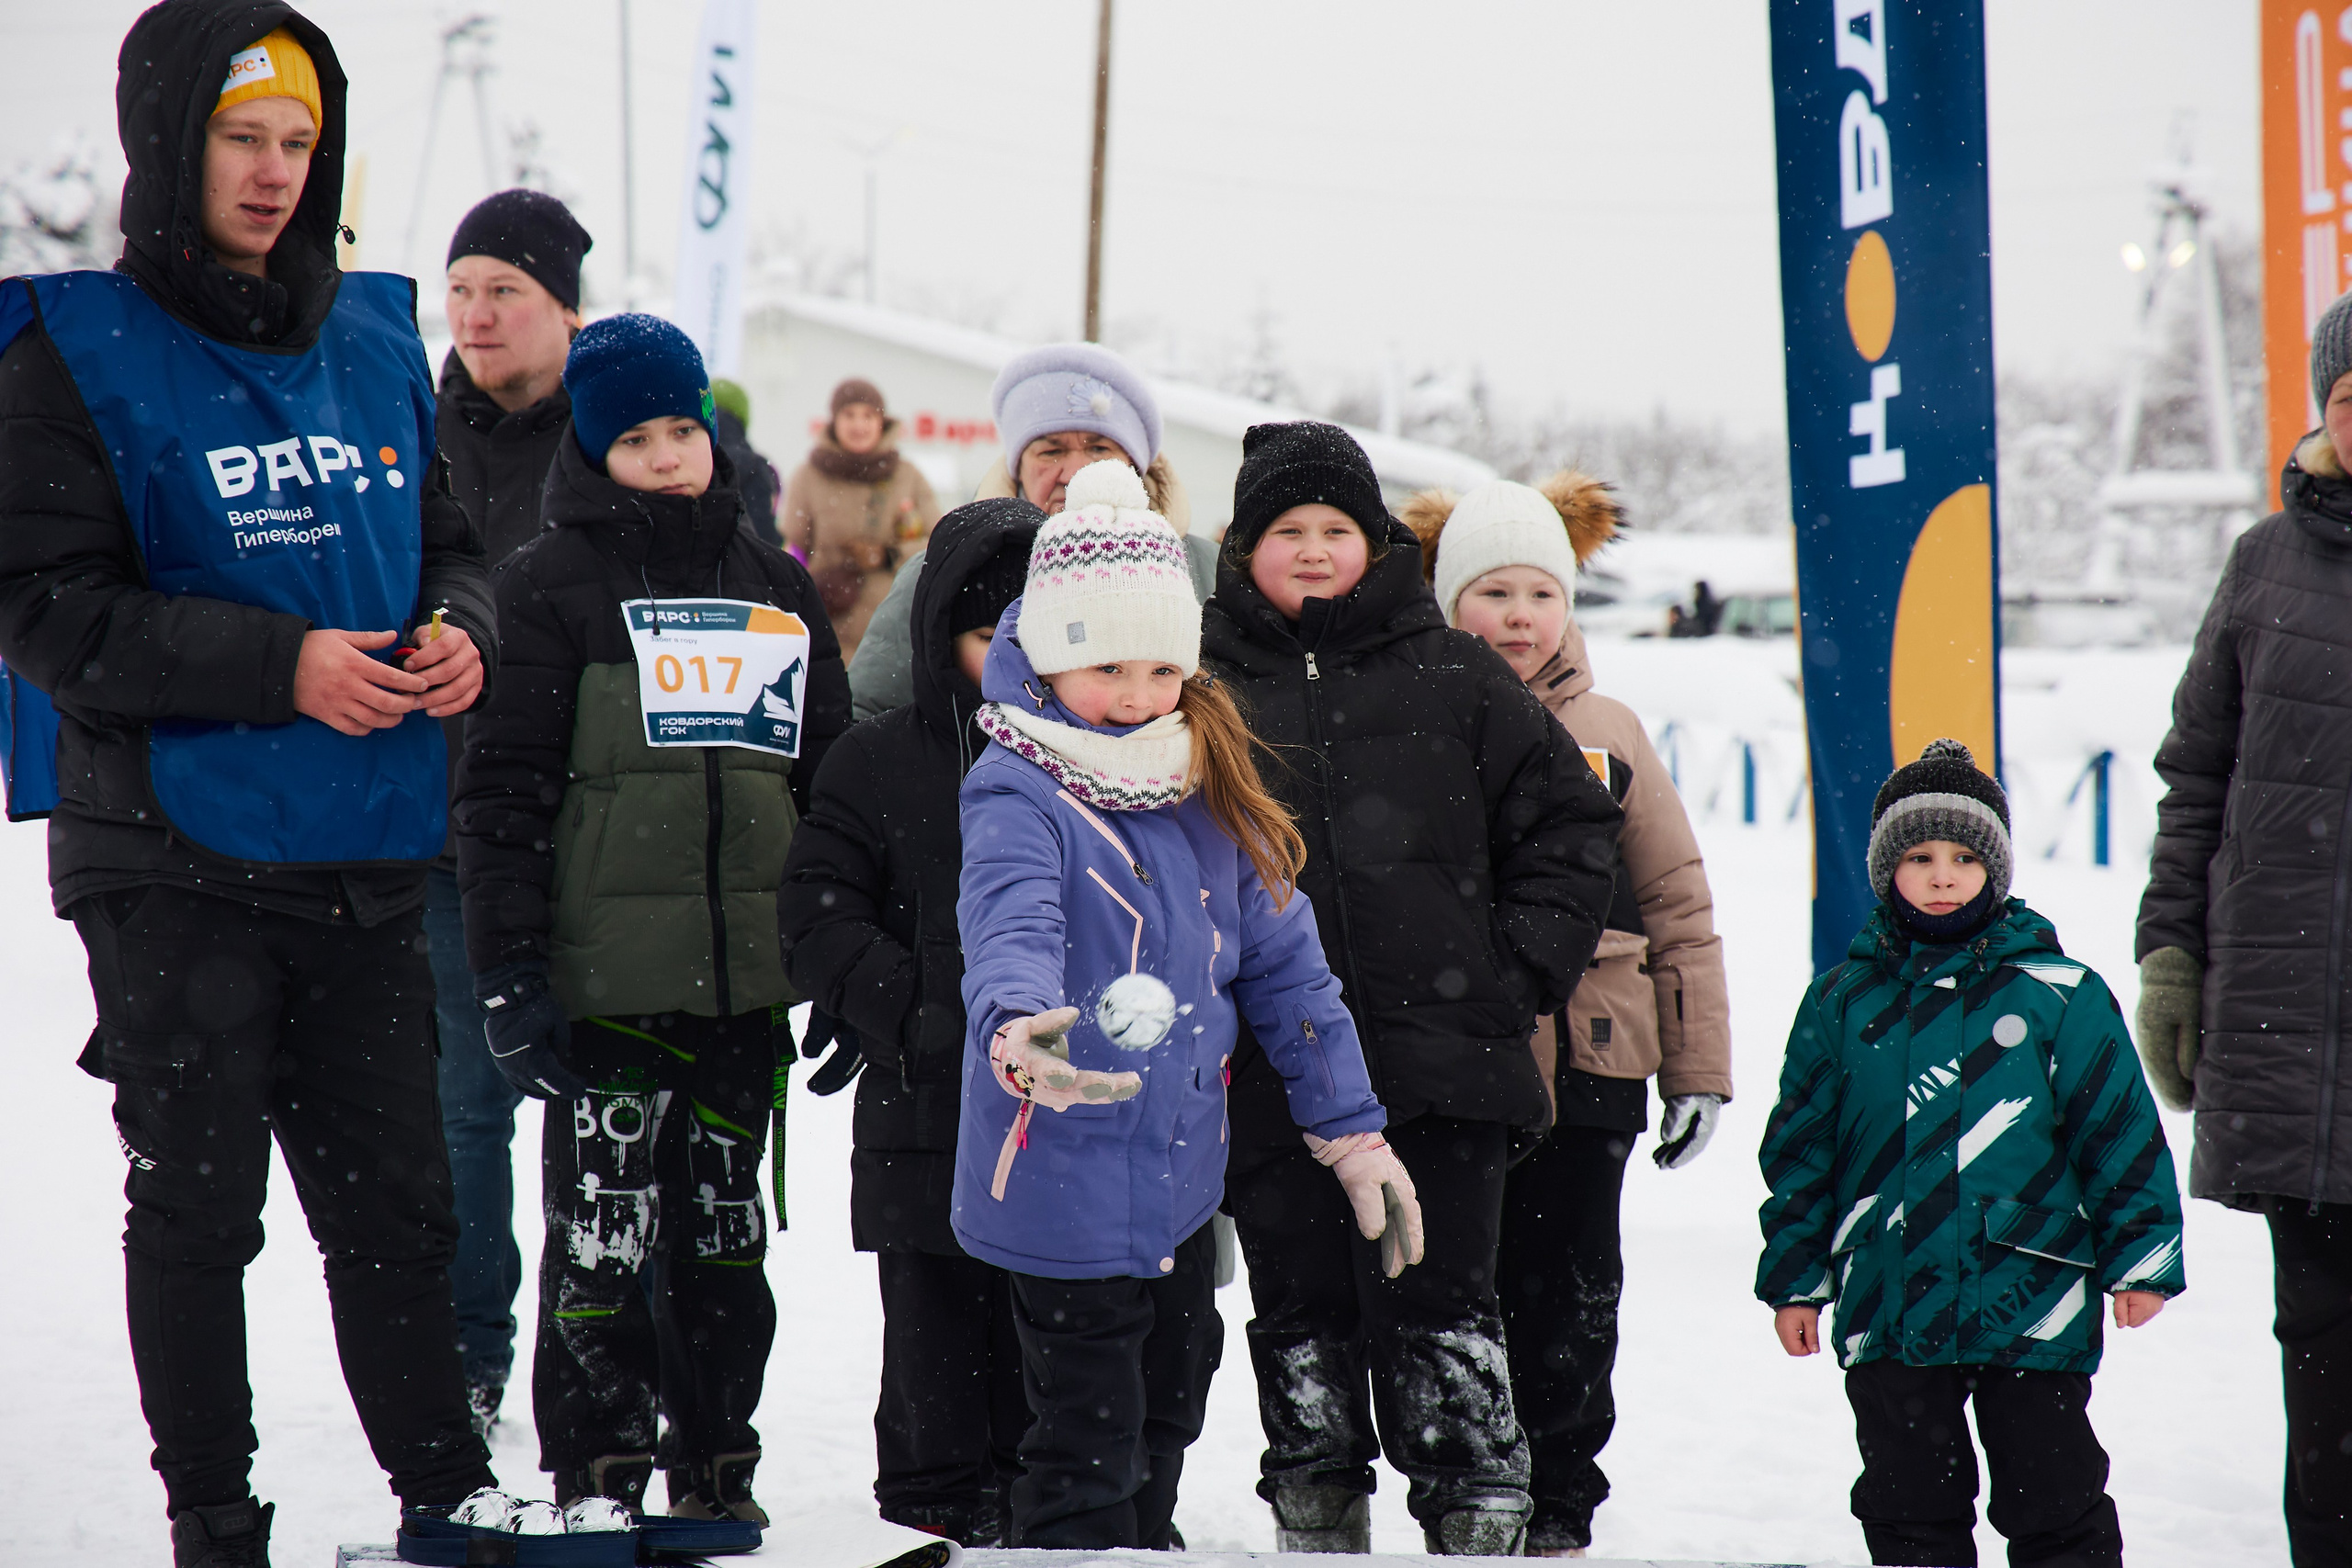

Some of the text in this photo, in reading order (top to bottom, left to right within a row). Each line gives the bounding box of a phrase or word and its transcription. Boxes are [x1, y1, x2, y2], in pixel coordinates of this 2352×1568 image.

[227, 506, 313, 526] Вершина
[642, 611, 690, 624] ВАРС
[654, 654, 742, 694] 017
[659, 717, 744, 727] КОВДОРСКИЙ
[660, 727, 687, 735] ГОК
